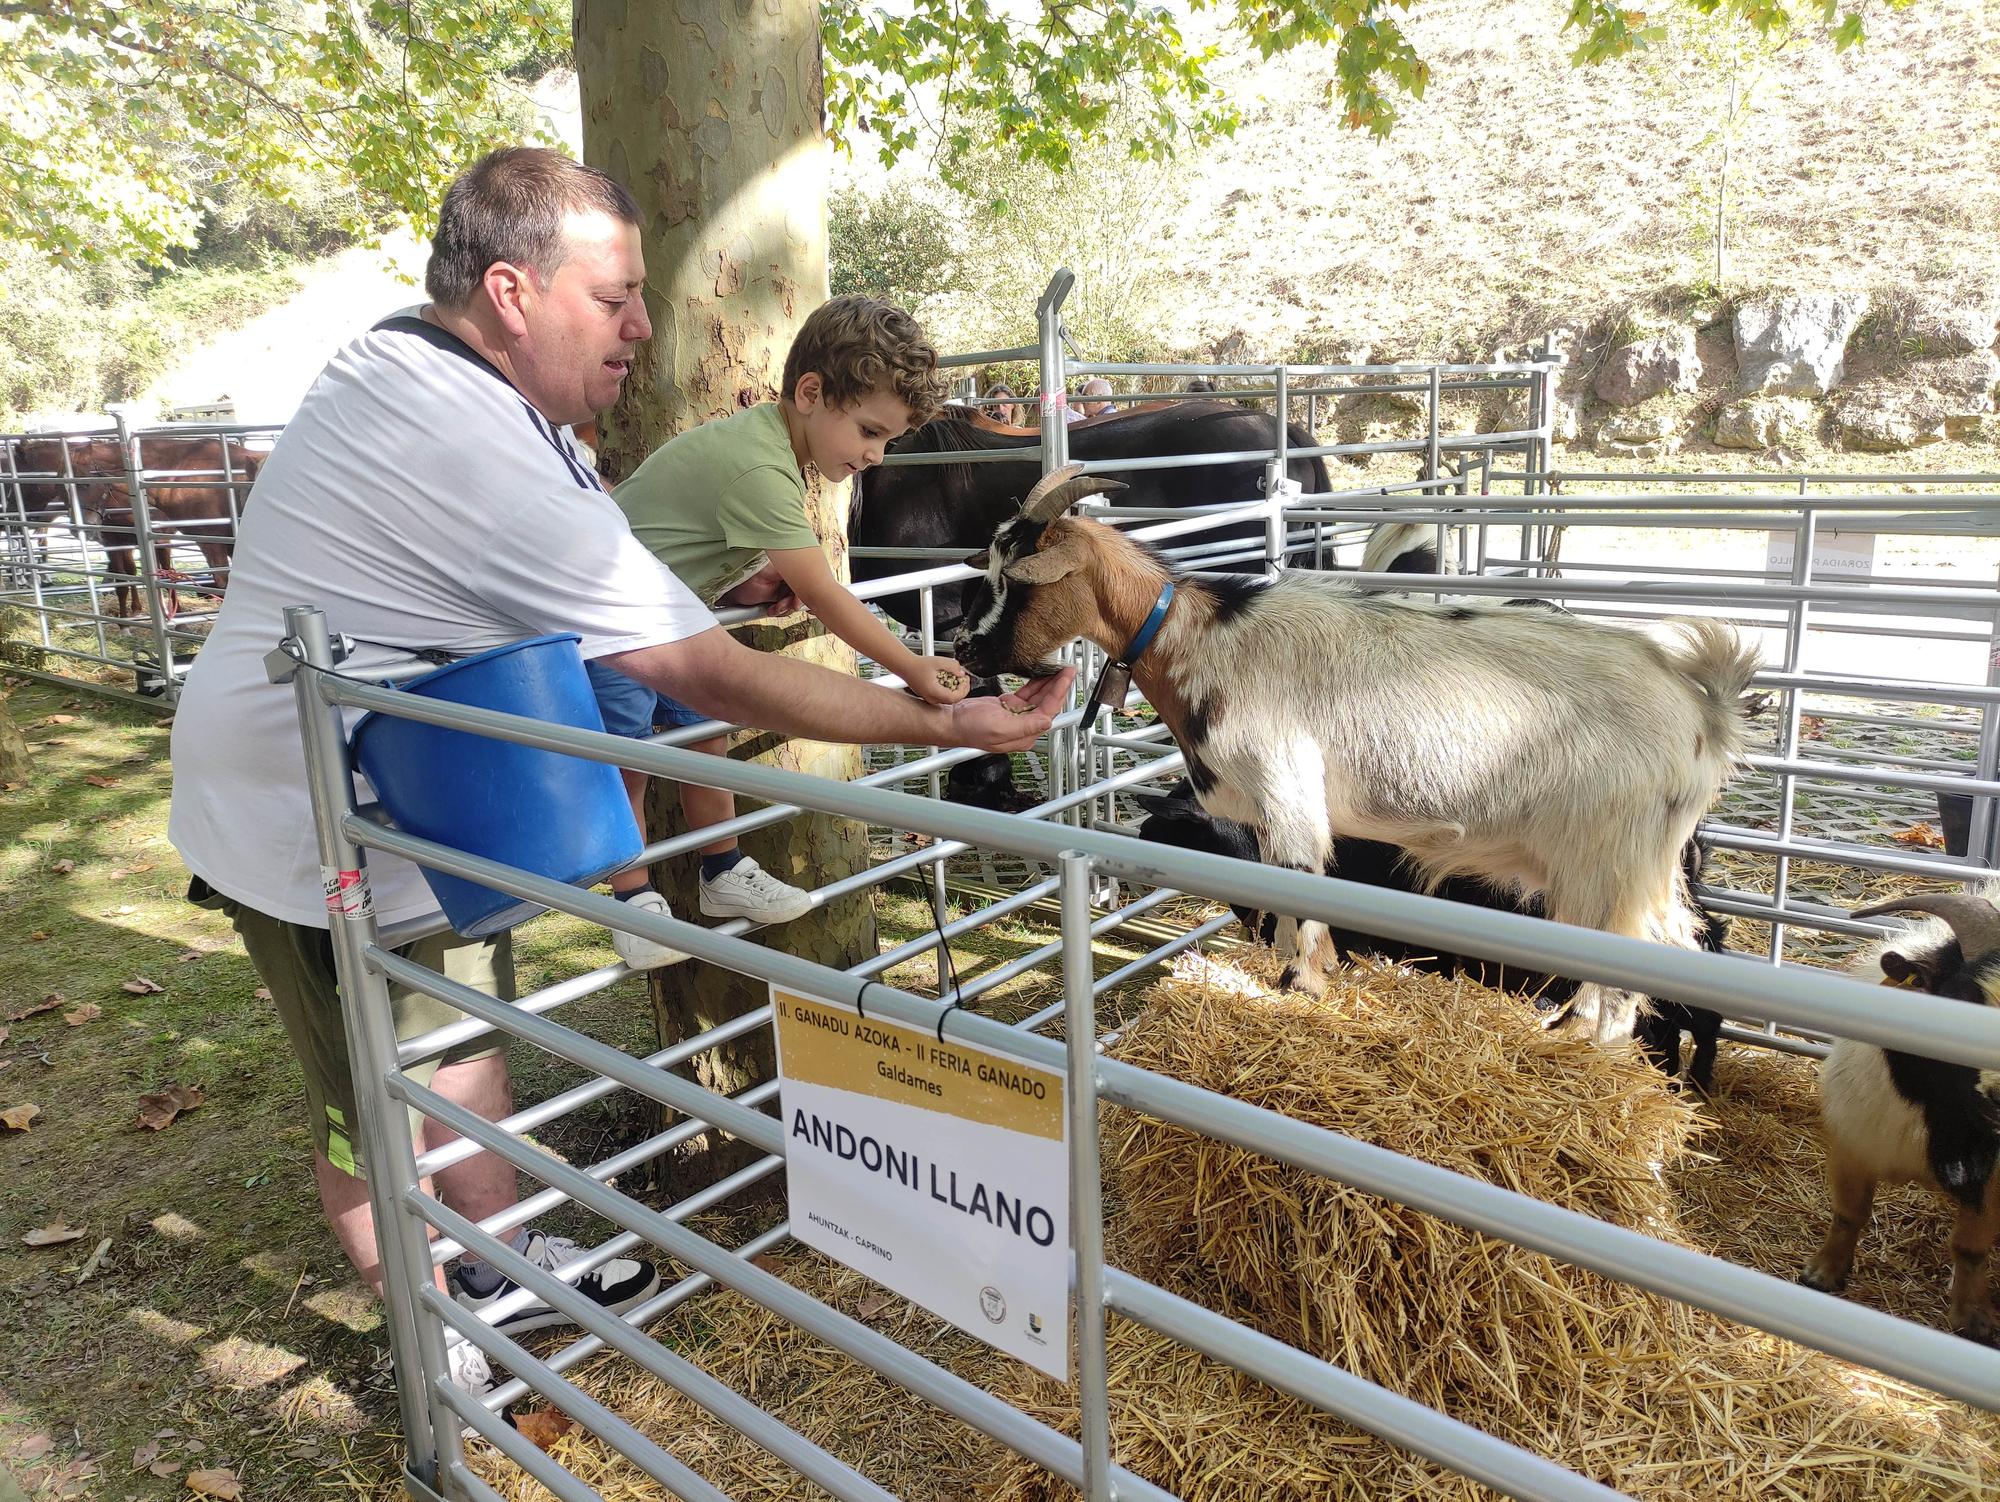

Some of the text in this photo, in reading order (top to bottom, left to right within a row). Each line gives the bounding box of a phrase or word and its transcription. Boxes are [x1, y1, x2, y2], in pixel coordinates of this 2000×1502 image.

[779, 1002, 791, 1018] II.
[794, 1007, 849, 1036] GANADU
[854, 1024, 901, 1053] AZOKA
[916, 1043, 925, 1061] II
[930, 1048, 972, 1077] FERIA
[977, 1064, 1046, 1100] GANADO
[877, 1060, 943, 1097] Galdames
[792, 1108, 1055, 1247] ANDONI LLANO
[808, 1211, 850, 1240] AHUNTZAK
[855, 1235, 893, 1261] CAPRINO
